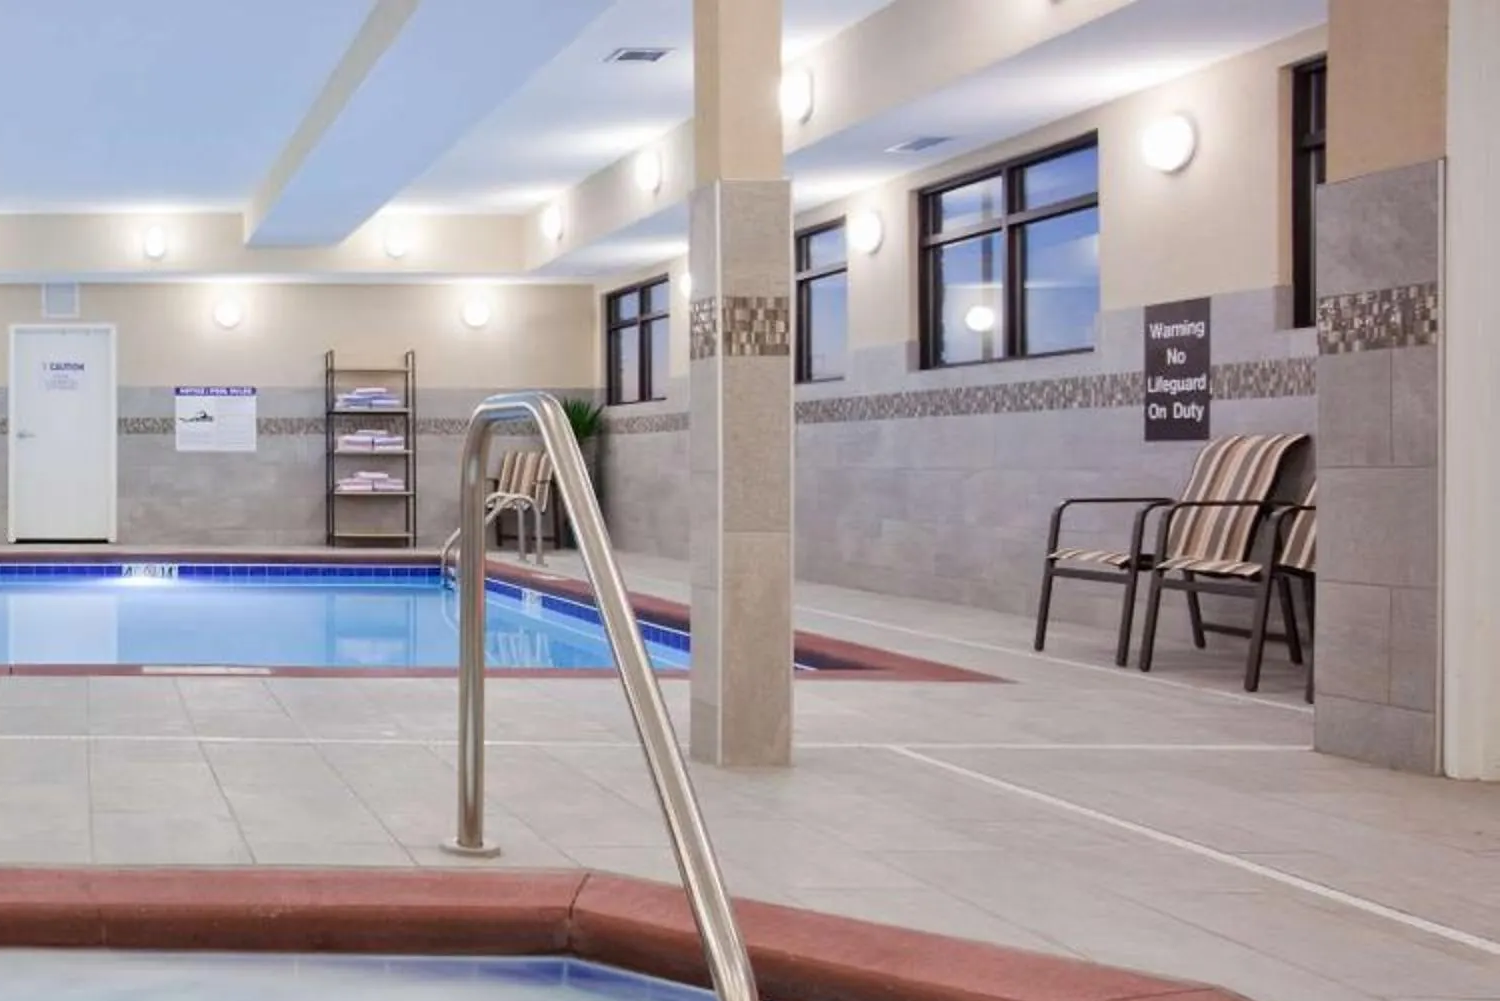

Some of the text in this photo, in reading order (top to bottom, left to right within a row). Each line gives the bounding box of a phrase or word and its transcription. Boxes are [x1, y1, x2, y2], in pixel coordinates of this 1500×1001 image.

[1149, 320, 1205, 339] Warning
[1166, 348, 1187, 365] No
[1147, 374, 1207, 395] Lifeguard
[1148, 402, 1205, 422] On Duty
